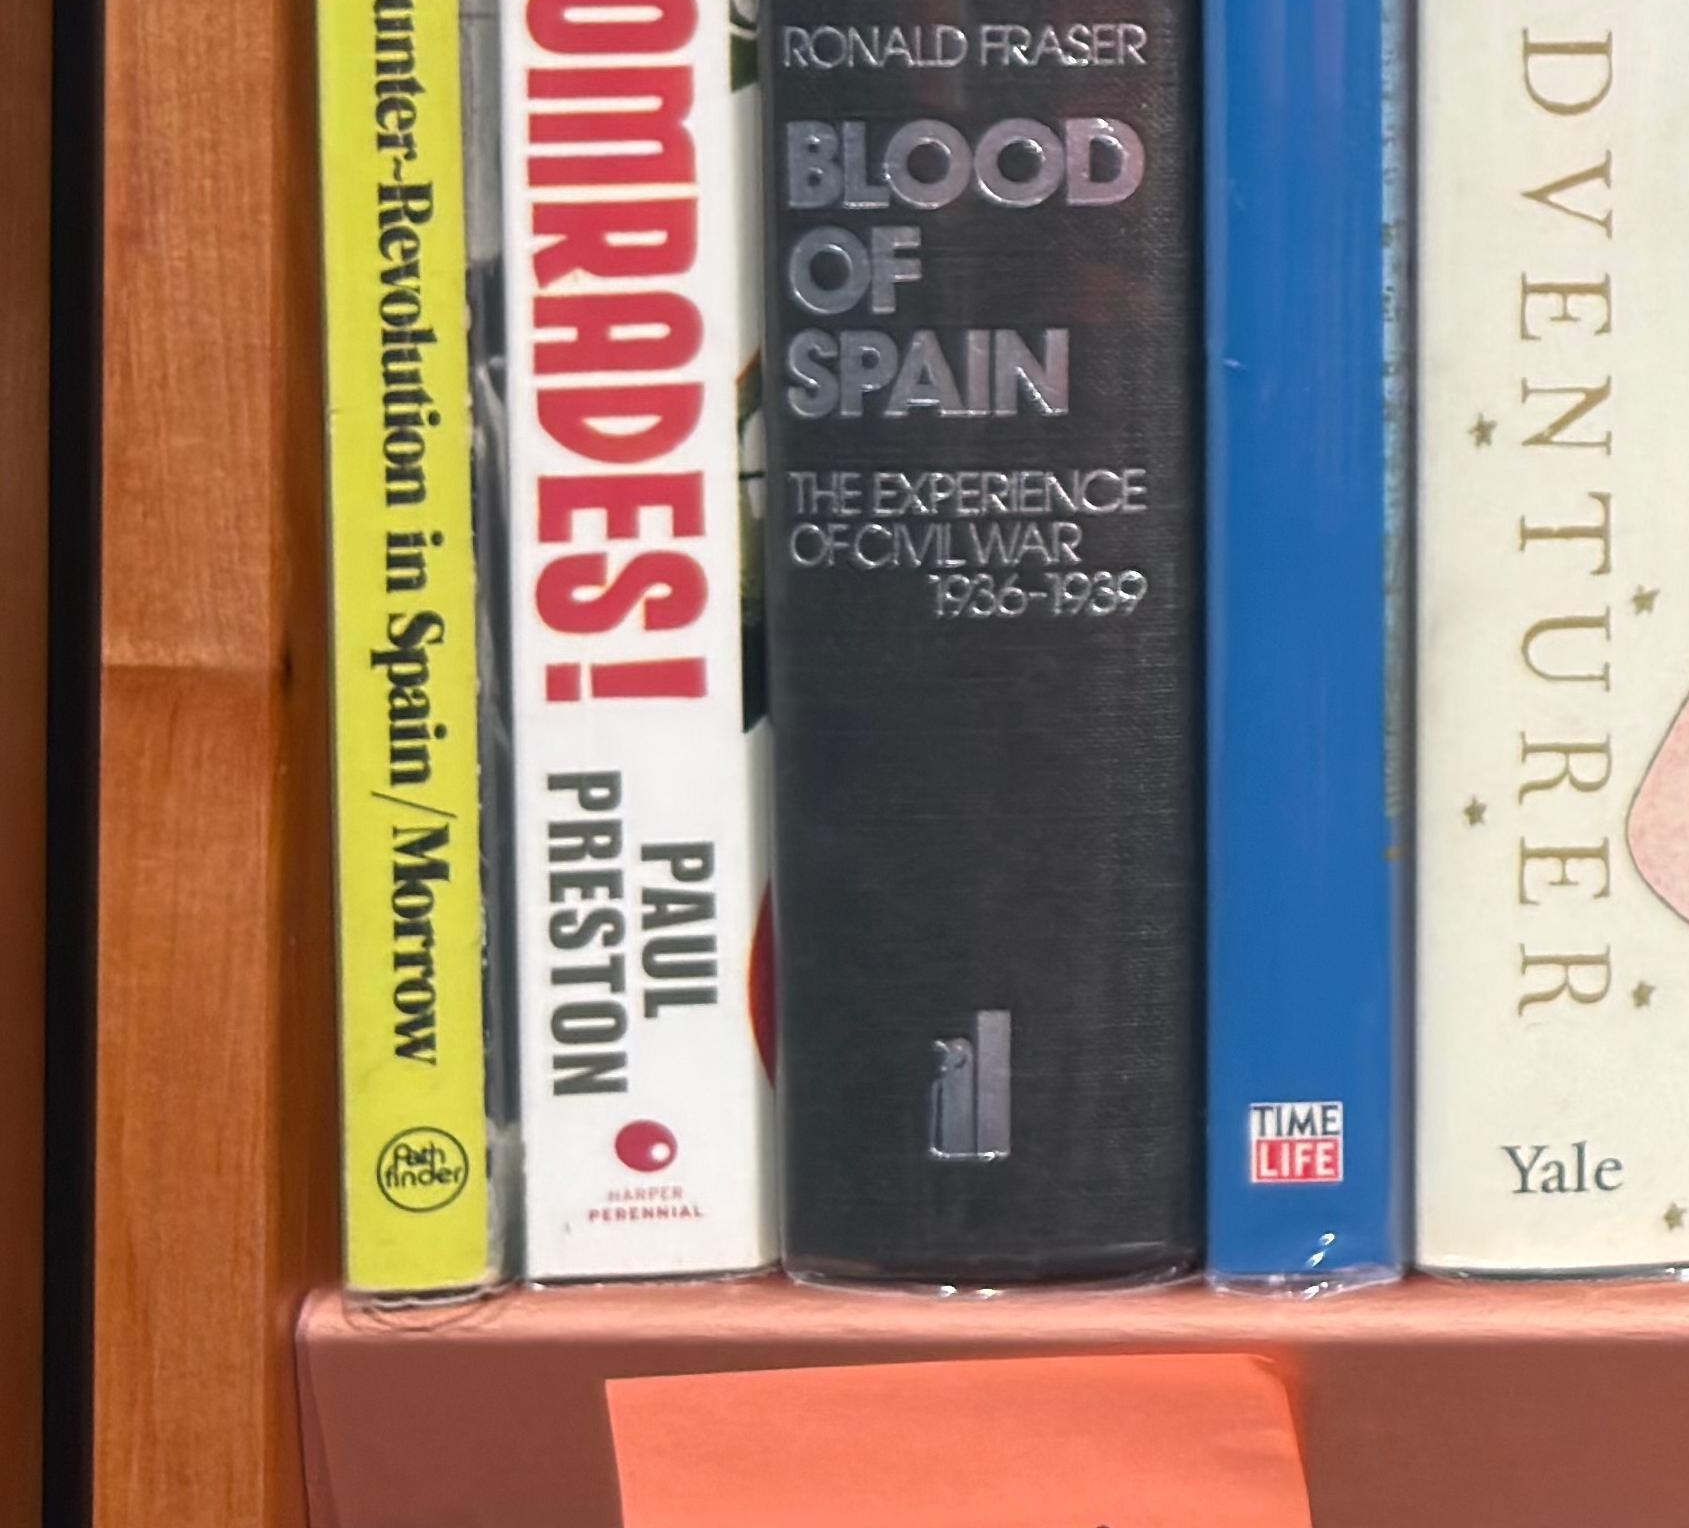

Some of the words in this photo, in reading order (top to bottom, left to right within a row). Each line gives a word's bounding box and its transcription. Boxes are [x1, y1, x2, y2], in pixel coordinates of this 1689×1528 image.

[784, 21, 968, 68] RONALD
[980, 21, 1147, 66] FRASER
[786, 118, 1144, 209] BLOOD
[787, 225, 922, 314] OF
[786, 327, 1071, 418] SPAIN
[788, 472, 861, 516] THE
[873, 469, 1147, 516] EXPERIENCE
[385, 531, 444, 594] in
[789, 523, 850, 567] OF
[854, 522, 966, 568] CIVIL
[968, 522, 1082, 565] WAR
[547, 772, 627, 1096] PRESTON
[641, 842, 717, 1019] PAUL
[1252, 1105, 1341, 1137] TIME
[385, 1164, 463, 1188] finder
[1257, 1142, 1337, 1178] LIFE
[1501, 1142, 1622, 1194] Yale
[588, 1206, 702, 1222] PERENNIAL
[608, 1187, 682, 1201] HARPER
